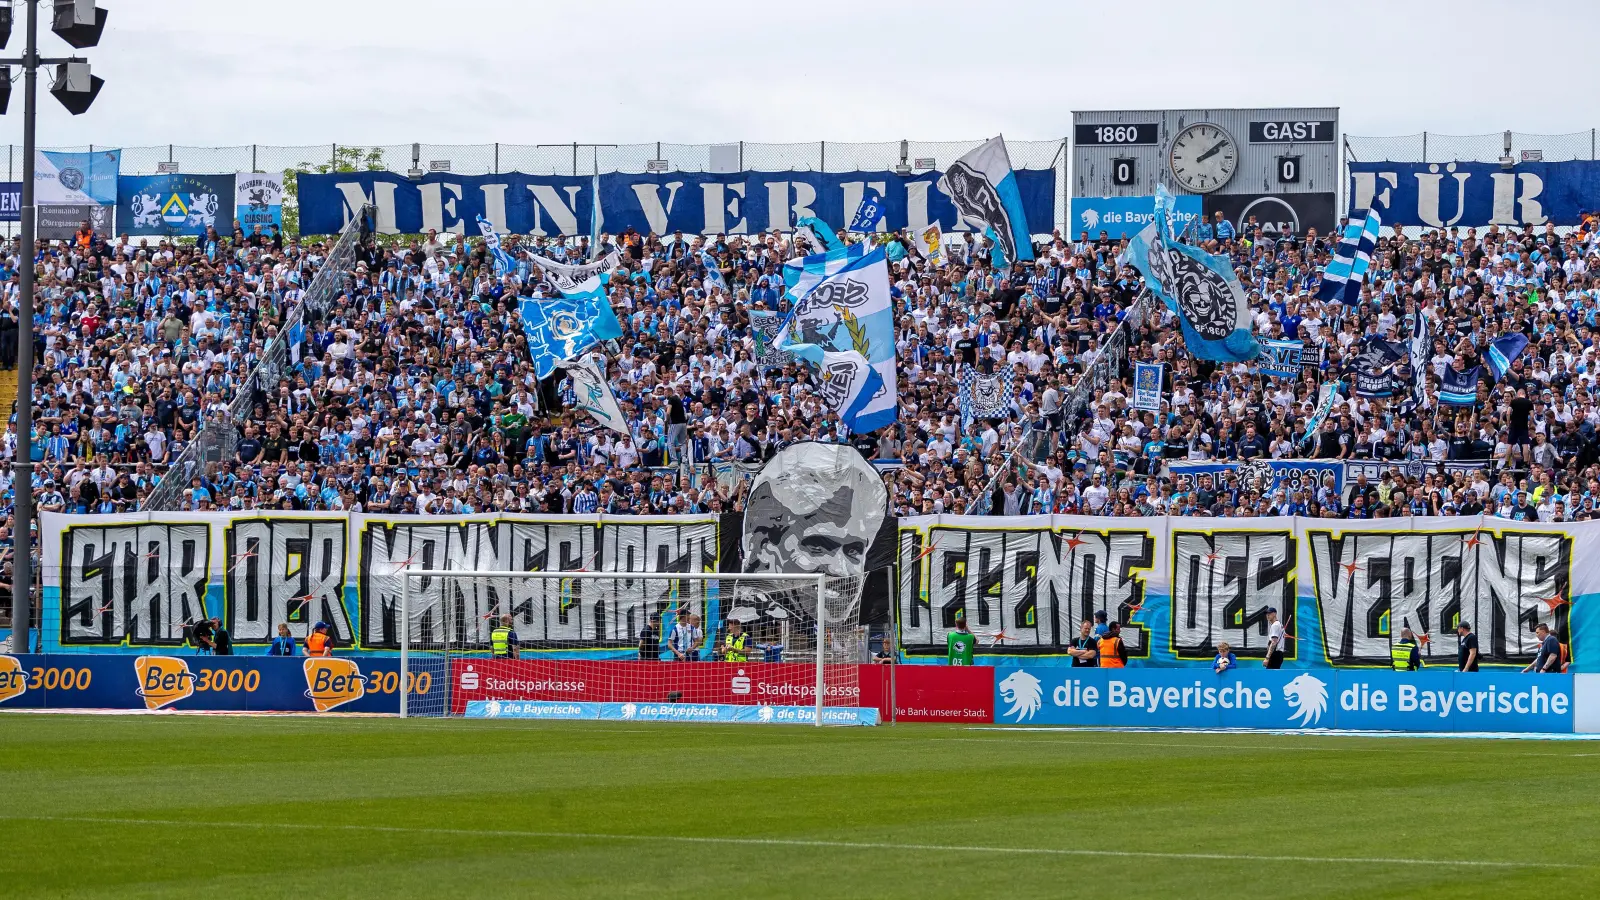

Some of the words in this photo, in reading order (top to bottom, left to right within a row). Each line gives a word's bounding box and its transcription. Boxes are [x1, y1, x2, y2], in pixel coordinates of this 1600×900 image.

[1095, 126, 1138, 143] 1860
[1263, 122, 1320, 139] GAST
[1118, 163, 1129, 182] 0
[1283, 161, 1294, 180] 0
[1351, 163, 1549, 228] FÜR
[335, 181, 582, 236] MEIN
[631, 180, 971, 237] VEREI
[1103, 211, 1122, 223] die
[1125, 210, 1192, 224] Bayeche
[65, 524, 209, 644] STAR
[230, 521, 352, 644] DER
[365, 522, 718, 647] MANNSCHAFT
[898, 529, 1152, 653] LEGENDE
[1174, 531, 1296, 657] DES
[1312, 532, 1571, 663] VEREINS
[28, 667, 92, 690] 3000
[145, 666, 190, 691] Bet
[196, 668, 260, 692] 3000
[313, 667, 360, 693] Bet
[485, 677, 585, 693] Stadtsparkasse
[757, 681, 860, 698] Stadtspakasse
[1053, 679, 1099, 708] die
[1108, 680, 1272, 714] Bayerische
[1340, 683, 1388, 712] die
[1398, 684, 1569, 718] Bayerische
[504, 704, 522, 714] die
[523, 704, 581, 717] Bayerische
[640, 705, 658, 716] die
[659, 706, 718, 718] Bayerische
[777, 709, 796, 720] die
[797, 709, 857, 722] Bayrische
[908, 707, 928, 717] Bank
[930, 708, 962, 718] unserer
[963, 708, 988, 719] Stadt.
